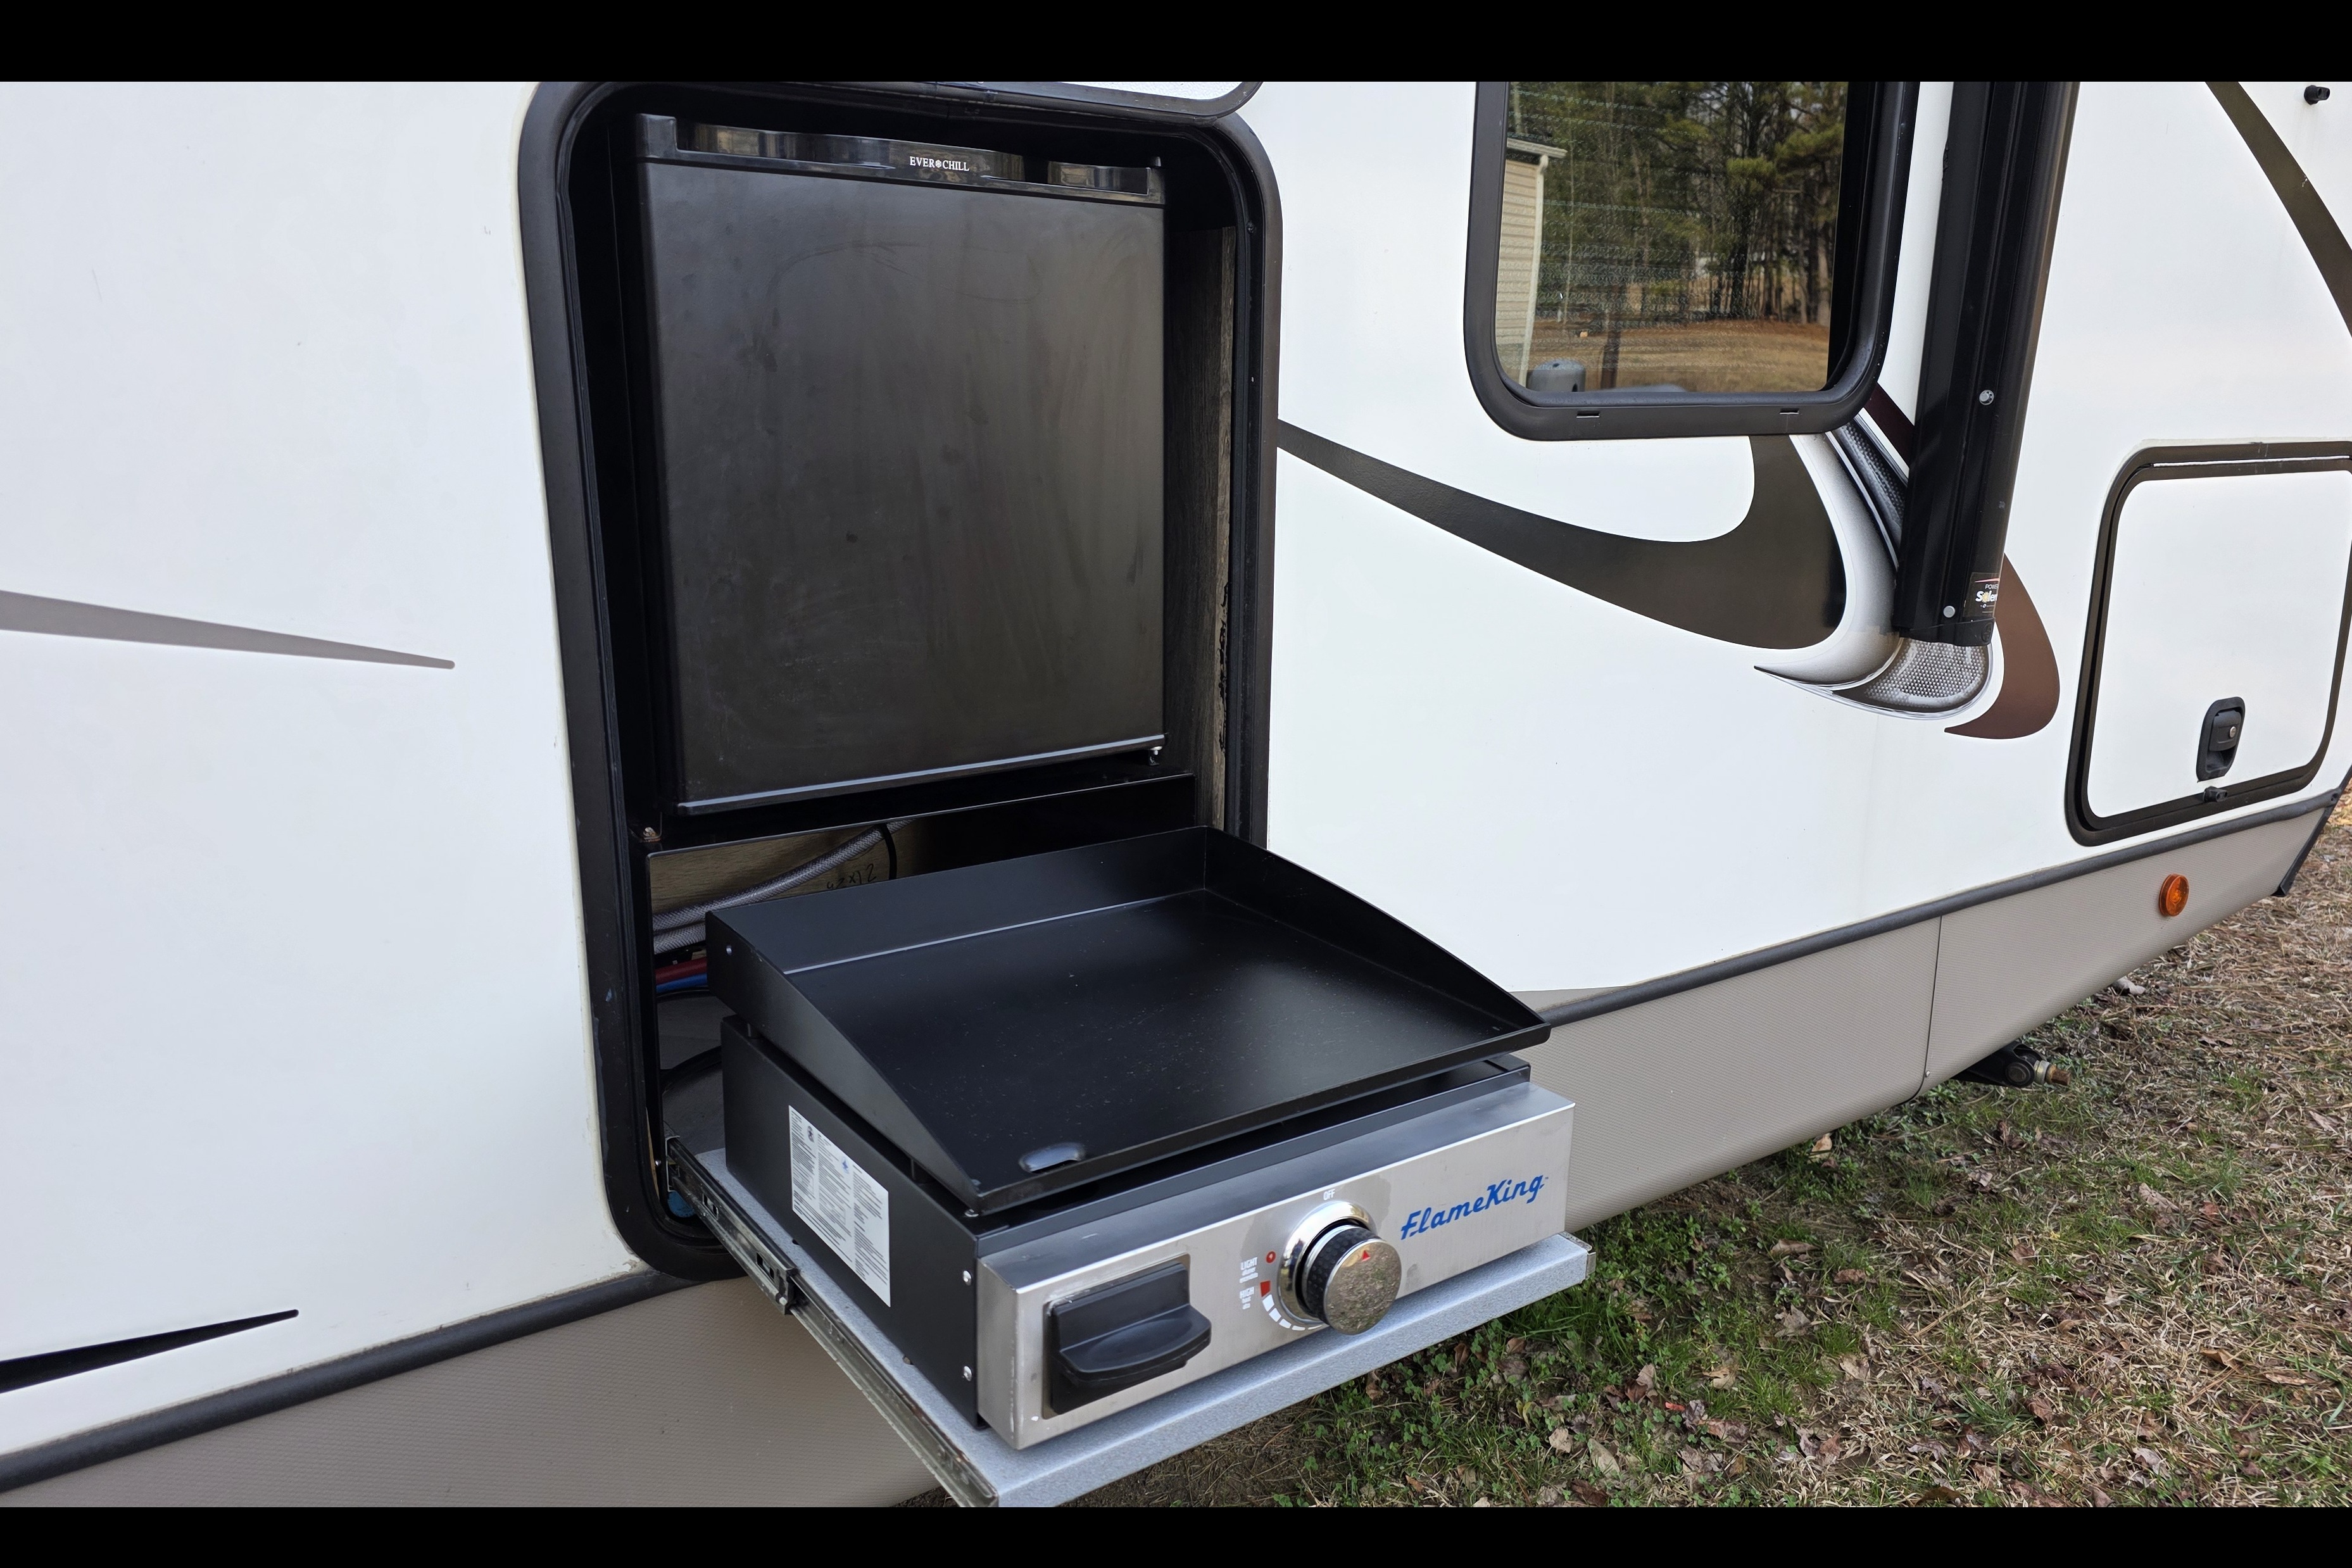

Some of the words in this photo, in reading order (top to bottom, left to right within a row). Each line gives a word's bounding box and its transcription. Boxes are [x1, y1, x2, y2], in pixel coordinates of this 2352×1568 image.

[1323, 1188, 1335, 1201] OFF
[1400, 1175, 1545, 1240] FlameKing
[1240, 1257, 1258, 1270] LIGHT
